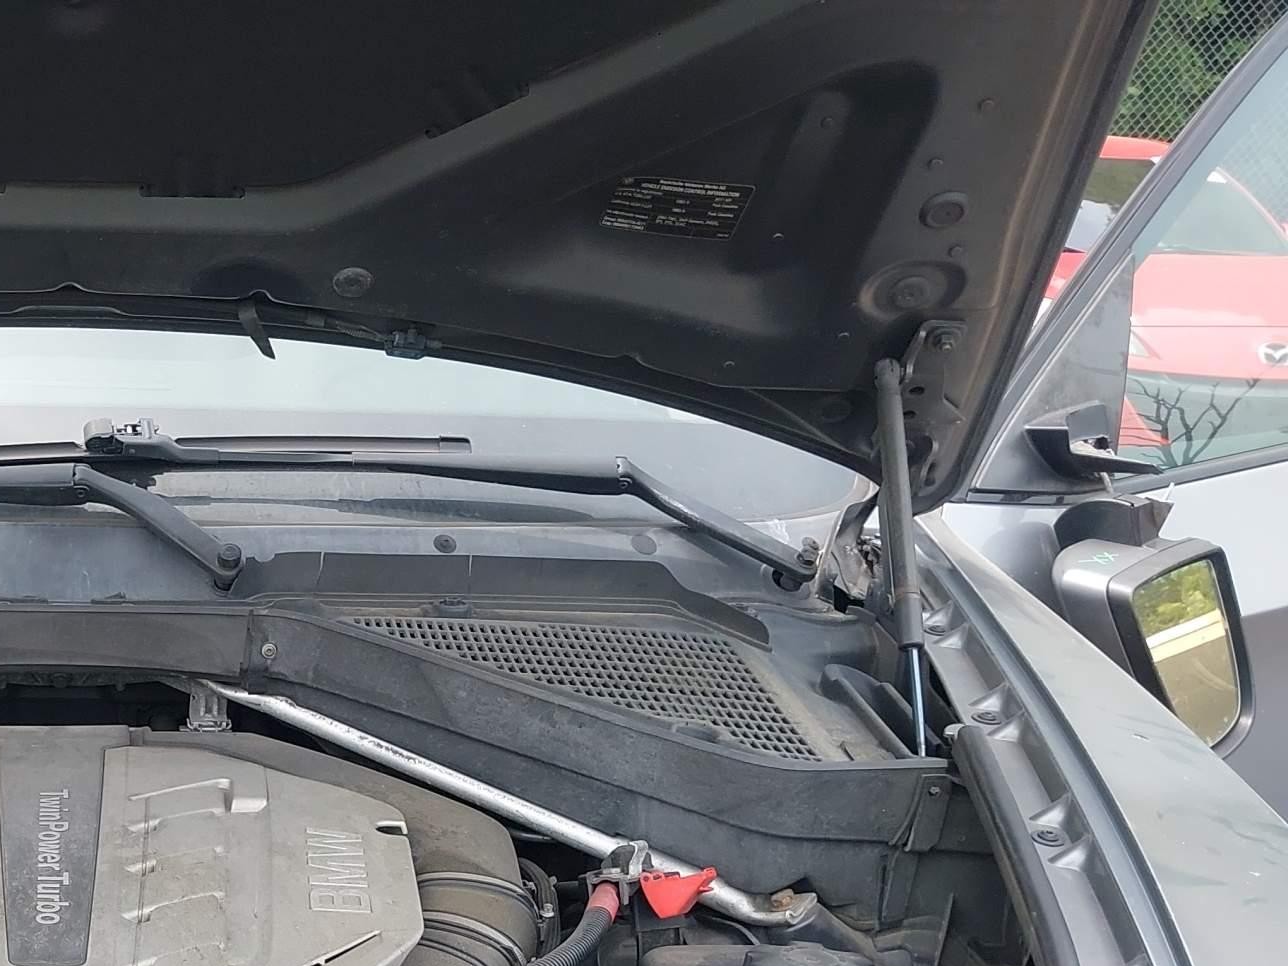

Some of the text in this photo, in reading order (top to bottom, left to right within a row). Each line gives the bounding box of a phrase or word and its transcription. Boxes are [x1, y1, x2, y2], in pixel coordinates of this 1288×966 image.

[35, 788, 71, 925] TwinPower Turbo
[305, 827, 373, 913] BMW
